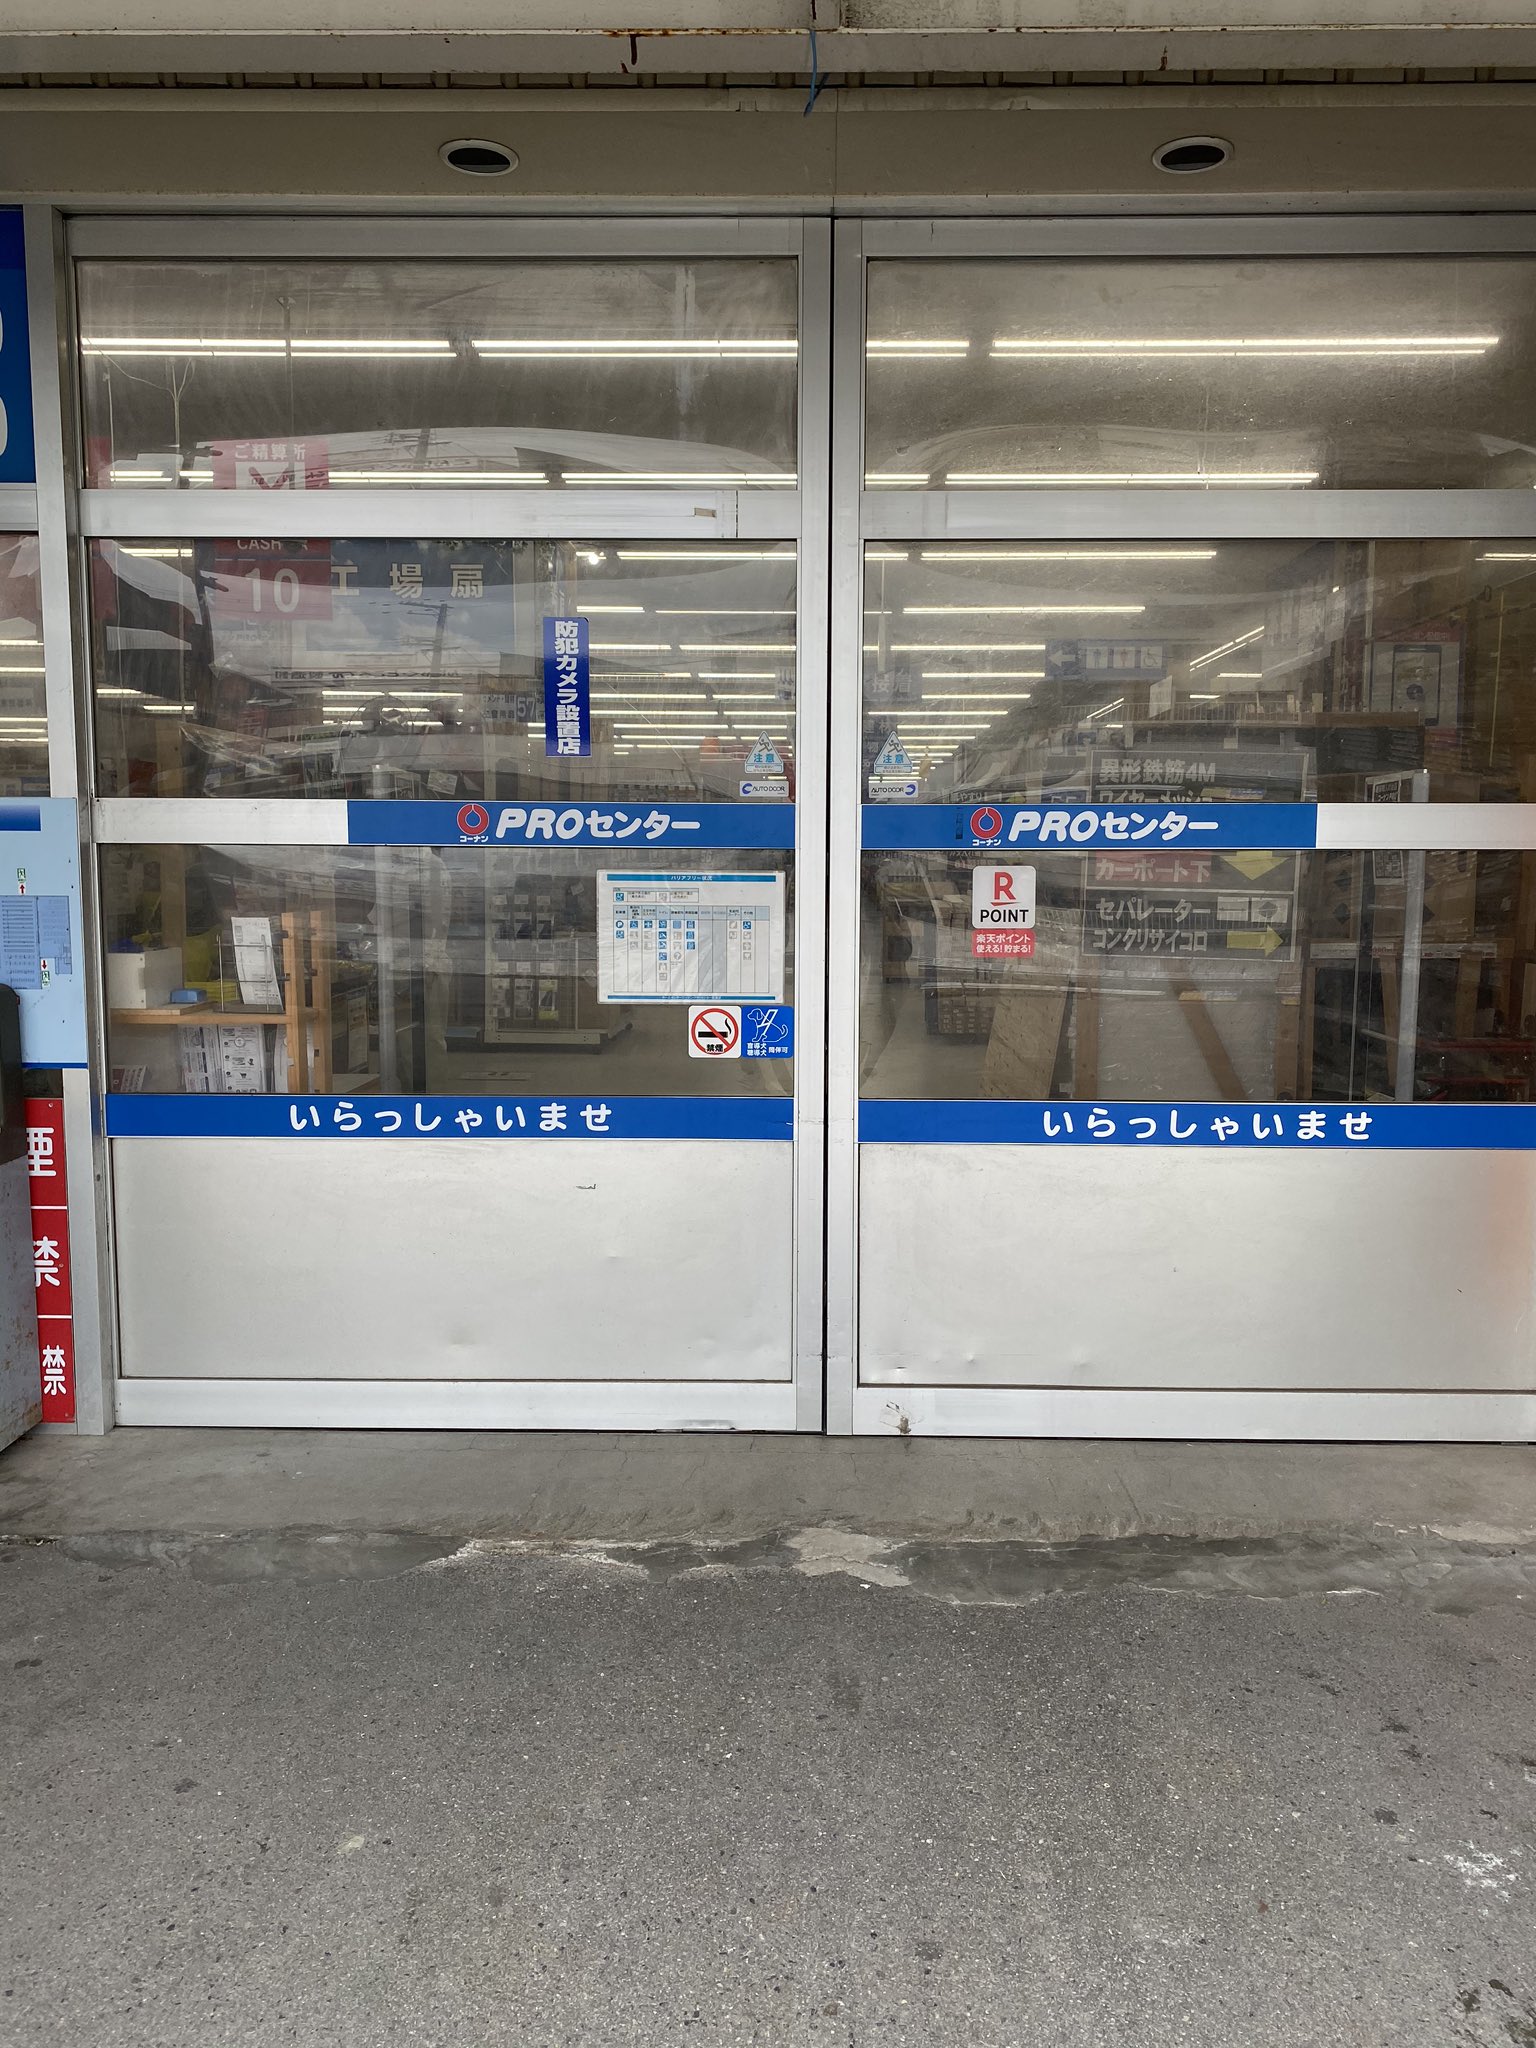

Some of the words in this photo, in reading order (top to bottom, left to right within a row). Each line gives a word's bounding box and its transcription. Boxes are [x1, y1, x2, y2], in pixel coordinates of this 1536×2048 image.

[235, 443, 306, 460] ご精算所
[245, 567, 299, 612] 10
[331, 563, 483, 599] 工場扇
[554, 620, 581, 755] 防犯カメラ設置店
[518, 697, 536, 718] 57
[753, 752, 775, 763] 注意
[882, 753, 904, 764] 注意
[1099, 758, 1217, 784] 異形鉄筋4M
[495, 808, 701, 840] PROセンター
[1008, 810, 1219, 842] PROセンター
[459, 835, 489, 843] コーナン
[972, 839, 1002, 847] コーナン
[1096, 857, 1212, 883] カーポート下
[994, 872, 1016, 900] R
[980, 909, 1029, 923] POINT
[1096, 896, 1211, 923] セパレーター
[976, 934, 1031, 944] 楽天ポイント
[1092, 927, 1209, 953] コンクリサイコロ
[706, 1044, 724, 1052] 禁煙
[289, 1101, 612, 1134] いらっしゃいませ
[1042, 1107, 1373, 1141] いらっしゃいませ
[42, 1344, 67, 1395] 禁
